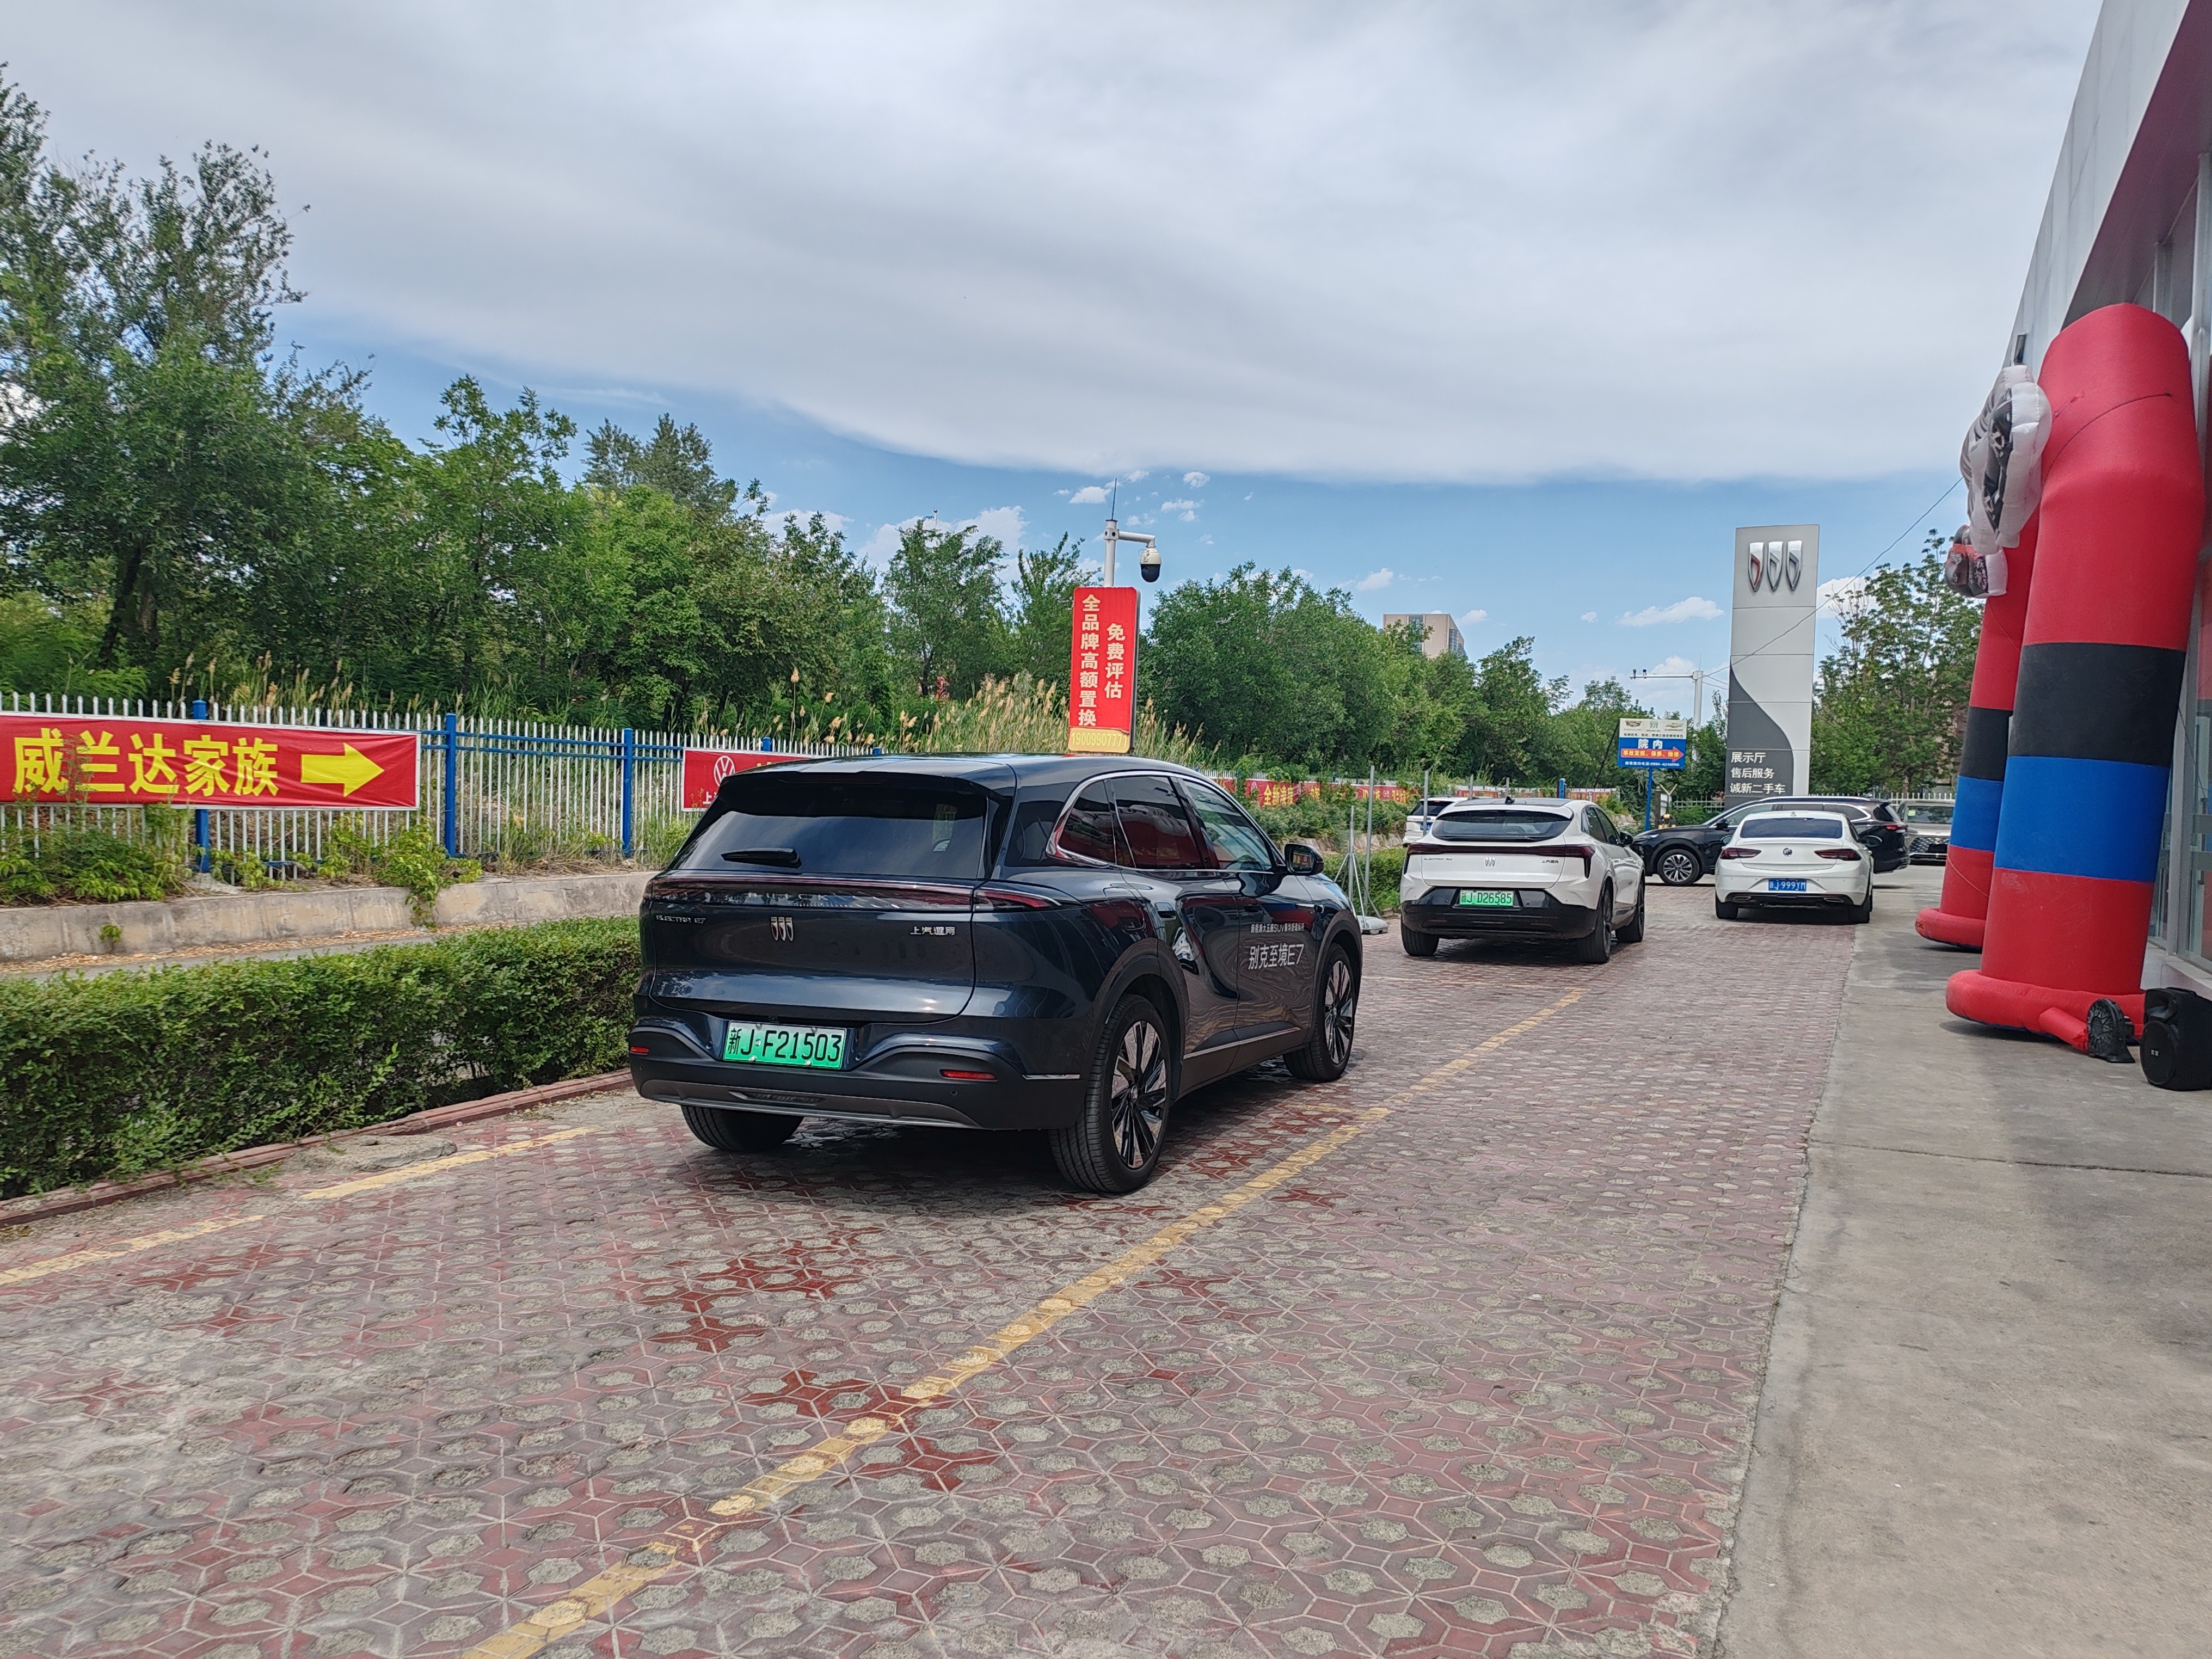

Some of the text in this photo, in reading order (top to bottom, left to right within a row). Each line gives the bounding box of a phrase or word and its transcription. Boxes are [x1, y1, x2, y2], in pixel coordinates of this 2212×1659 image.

[1078, 594, 1101, 727] 全品牌高额置换
[1104, 623, 1126, 699] 免费评估
[1071, 732, 1128, 747] 19009907771
[13, 728, 280, 796] 威兰达家族
[1731, 752, 1766, 763] 展示厅
[1731, 767, 1775, 779] 售后服务
[1730, 783, 1786, 794] 诚新二手车
[910, 926, 956, 936] 上汽通用
[1248, 943, 1304, 970] 别克至境E7
